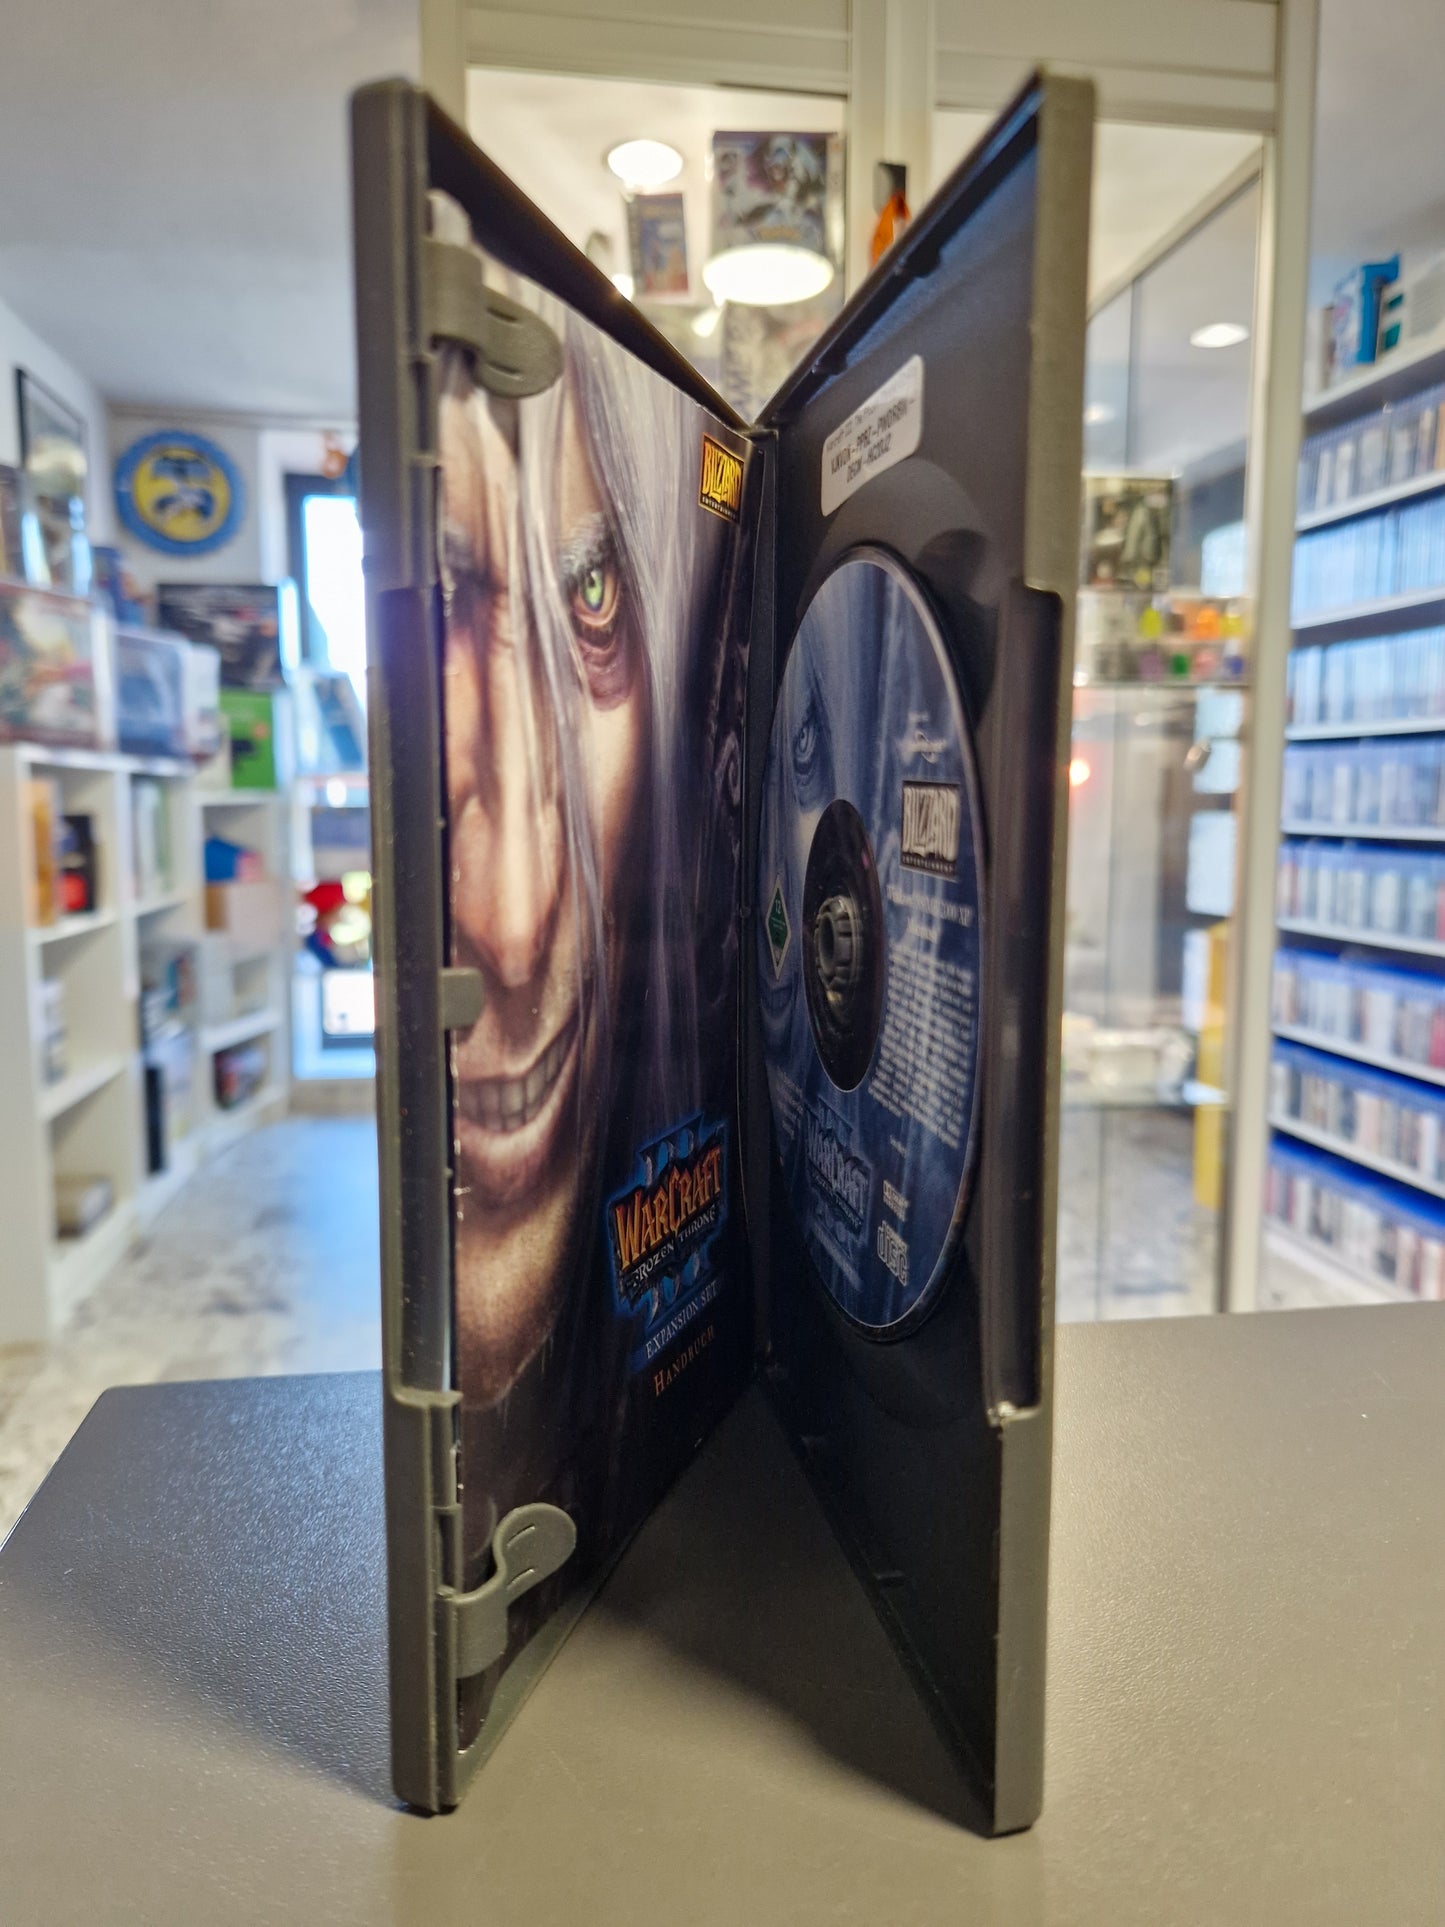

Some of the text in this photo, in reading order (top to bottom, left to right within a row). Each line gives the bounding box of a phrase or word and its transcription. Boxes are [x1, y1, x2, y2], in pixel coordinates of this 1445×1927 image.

[702, 441, 742, 511] BLIZZARD
[902, 786, 959, 861] BLIZZARD
[614, 1144, 722, 1273] WARCRAFT
[631, 1204, 718, 1289] FROZEN THRONE
[645, 1280, 719, 1360] EXPANSION SET
[653, 1324, 715, 1397] HANDBUCH
